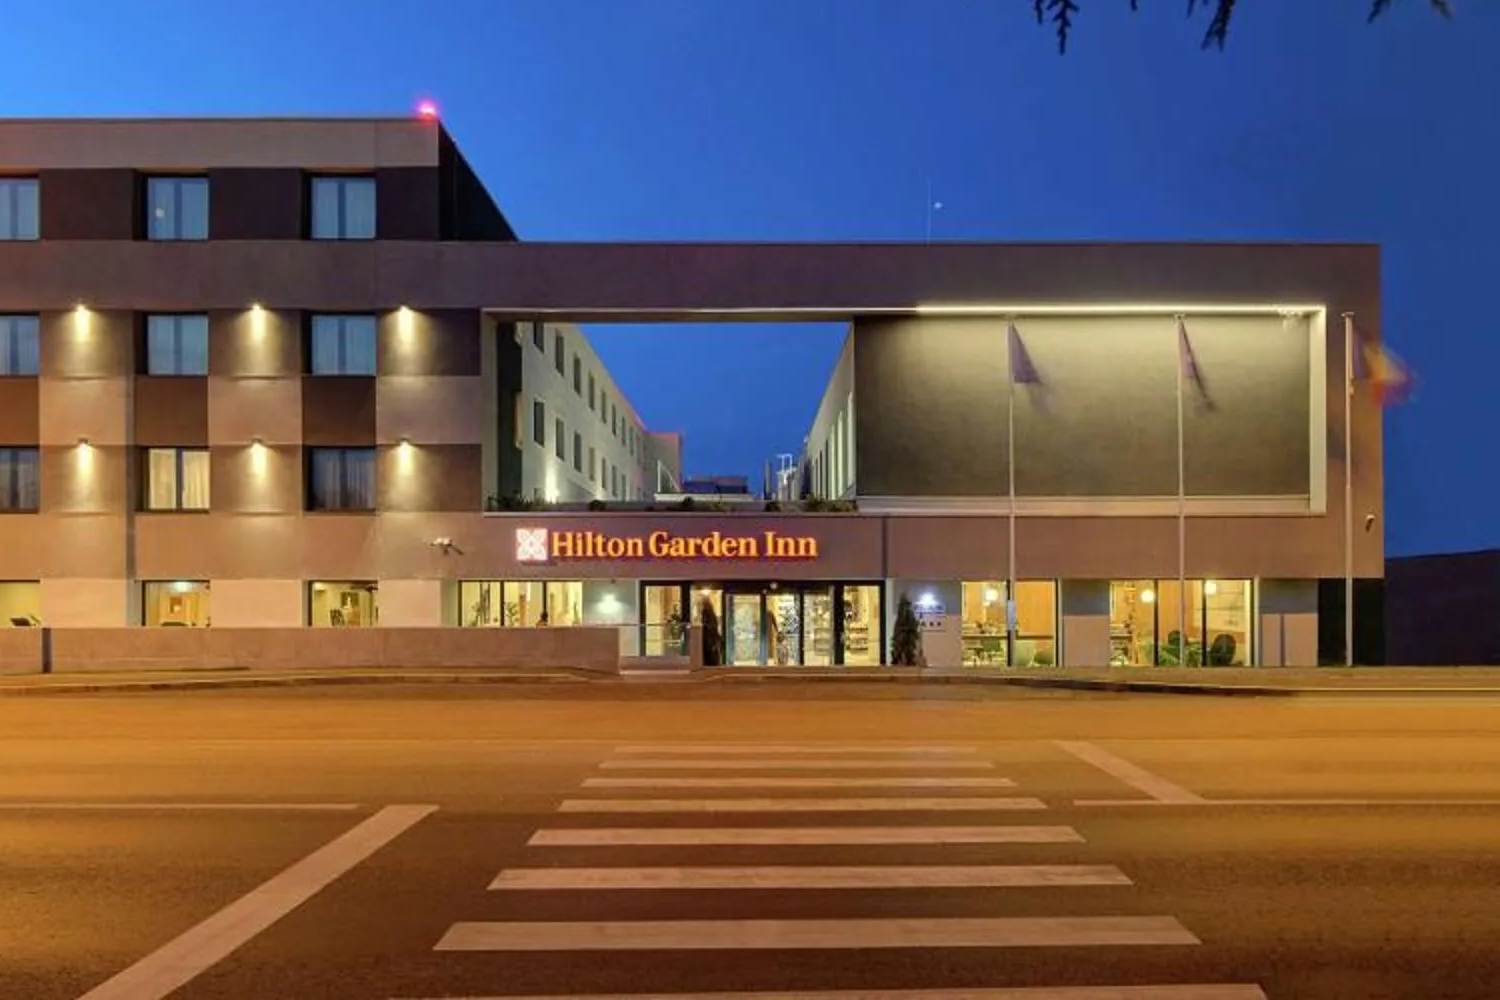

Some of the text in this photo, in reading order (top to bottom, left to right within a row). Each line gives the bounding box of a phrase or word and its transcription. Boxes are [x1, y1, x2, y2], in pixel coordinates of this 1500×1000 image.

[551, 531, 819, 557] Hilton Garden Inn
